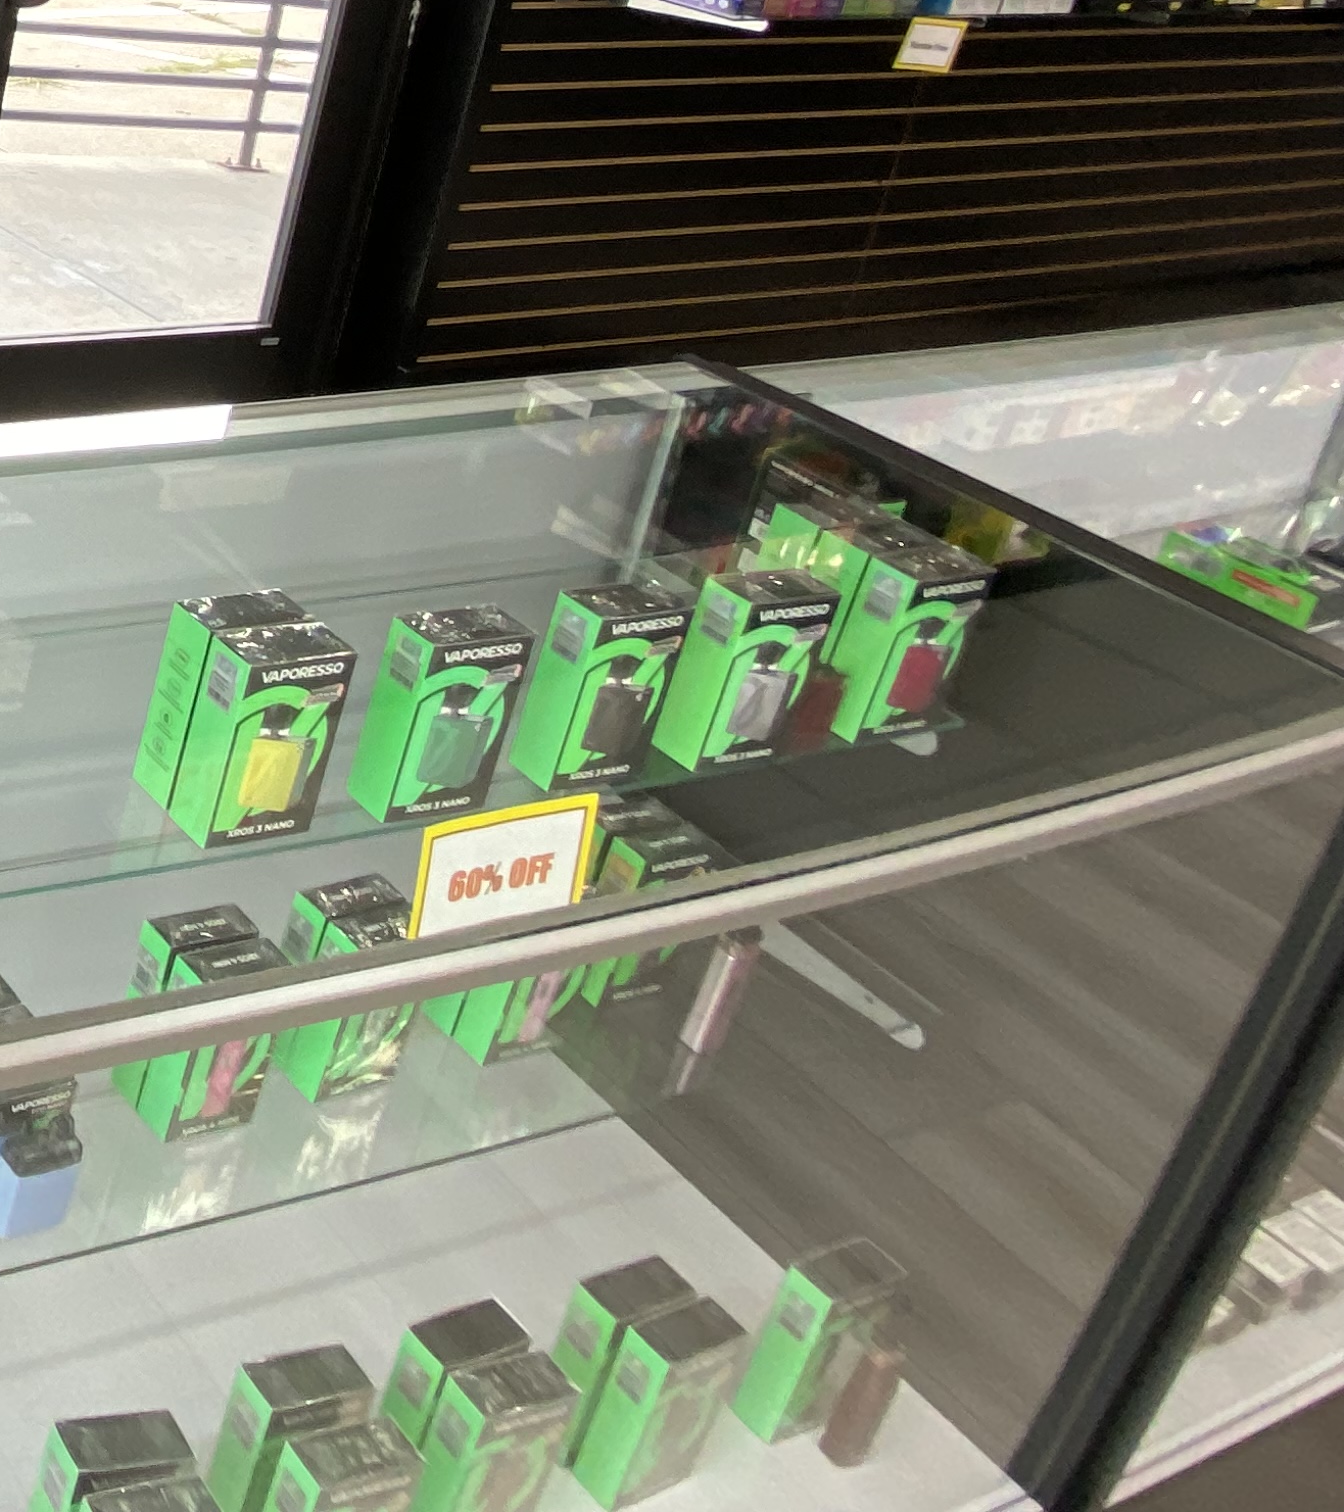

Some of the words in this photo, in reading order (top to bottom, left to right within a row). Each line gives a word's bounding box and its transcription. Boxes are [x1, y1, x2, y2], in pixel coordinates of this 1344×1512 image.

[759, 603, 830, 623] VAPORESSO
[611, 615, 685, 636] VAPORESSO
[444, 643, 523, 664] VAPORESSO
[262, 662, 344, 684] VAPORESSO
[443, 797, 471, 808] NANO
[267, 820, 294, 832] NANO
[447, 862, 503, 902] 60%
[508, 852, 555, 888] OFF
